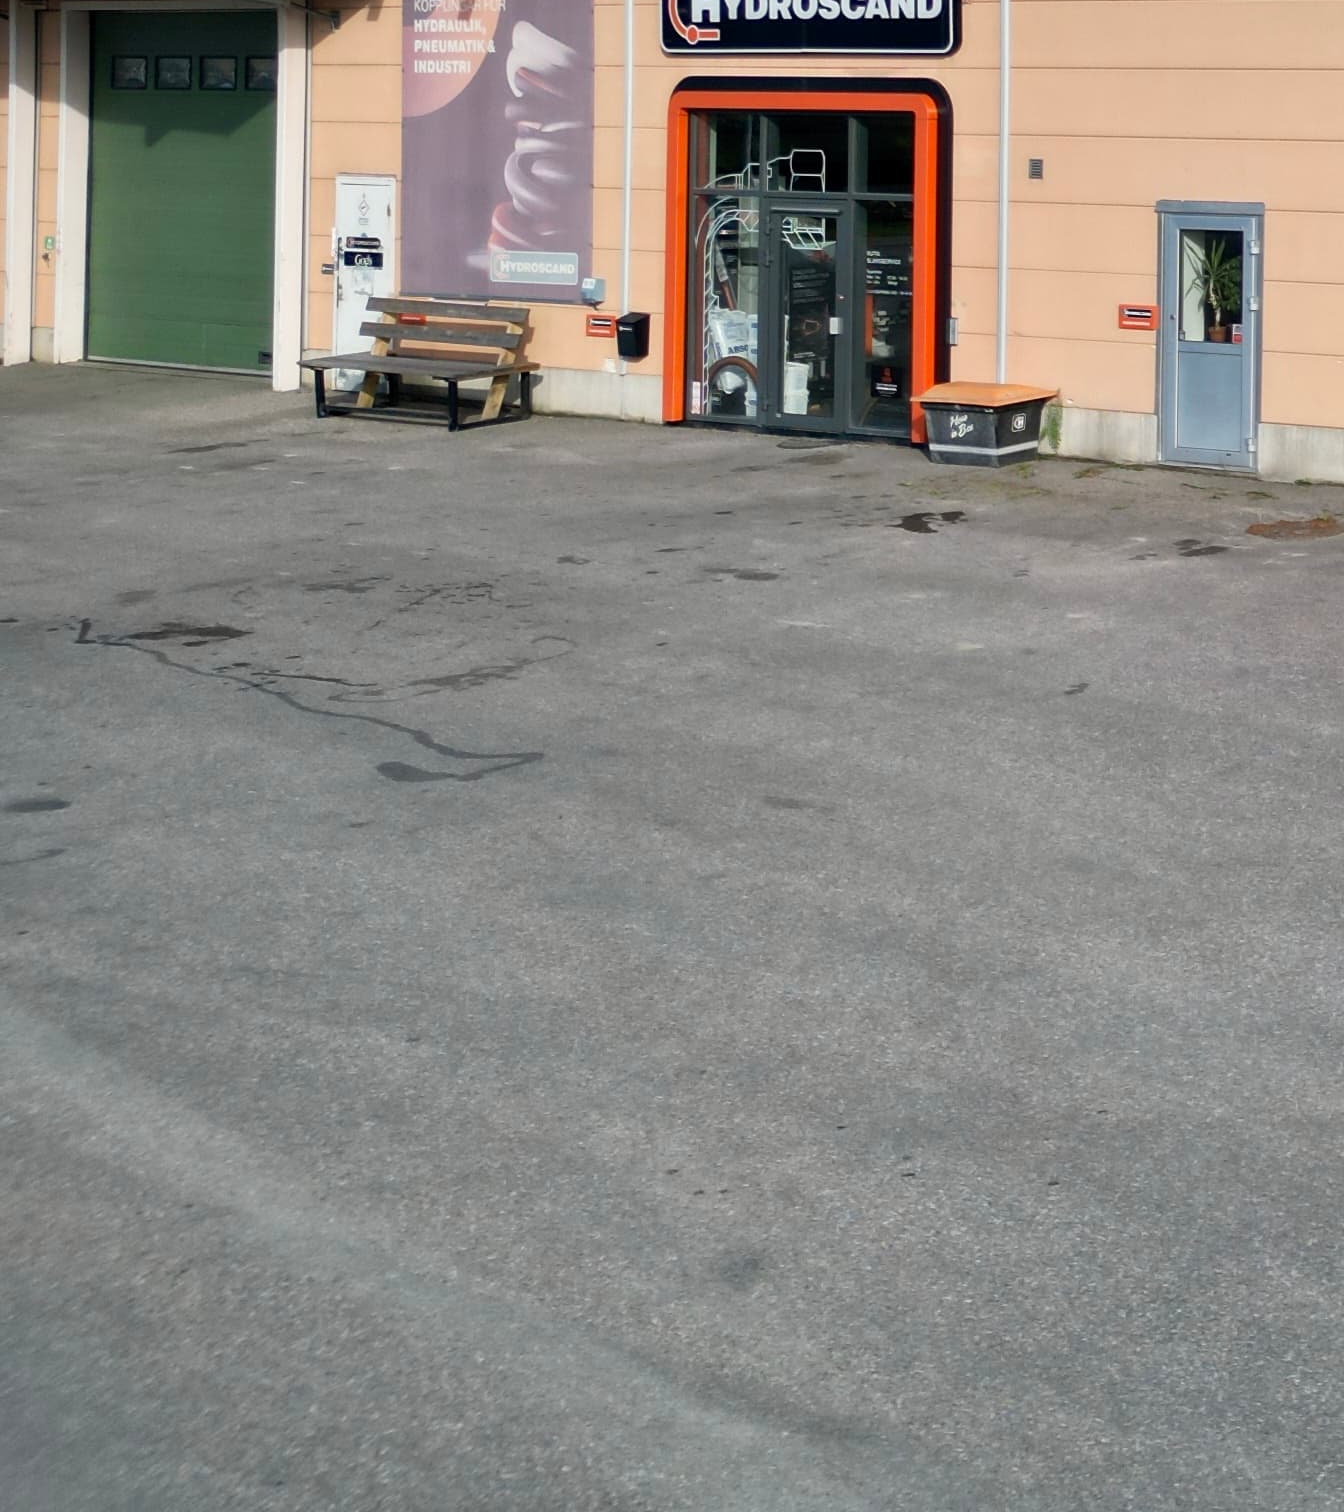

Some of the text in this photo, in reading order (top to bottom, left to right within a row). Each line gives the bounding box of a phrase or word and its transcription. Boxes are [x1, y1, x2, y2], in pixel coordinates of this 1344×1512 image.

[413, 18, 486, 35] HYDRAULIK,
[413, 38, 496, 54] PNEUMATIK &
[413, 59, 471, 75] INDUSTRI
[500, 259, 575, 275] HYDROSCAND
